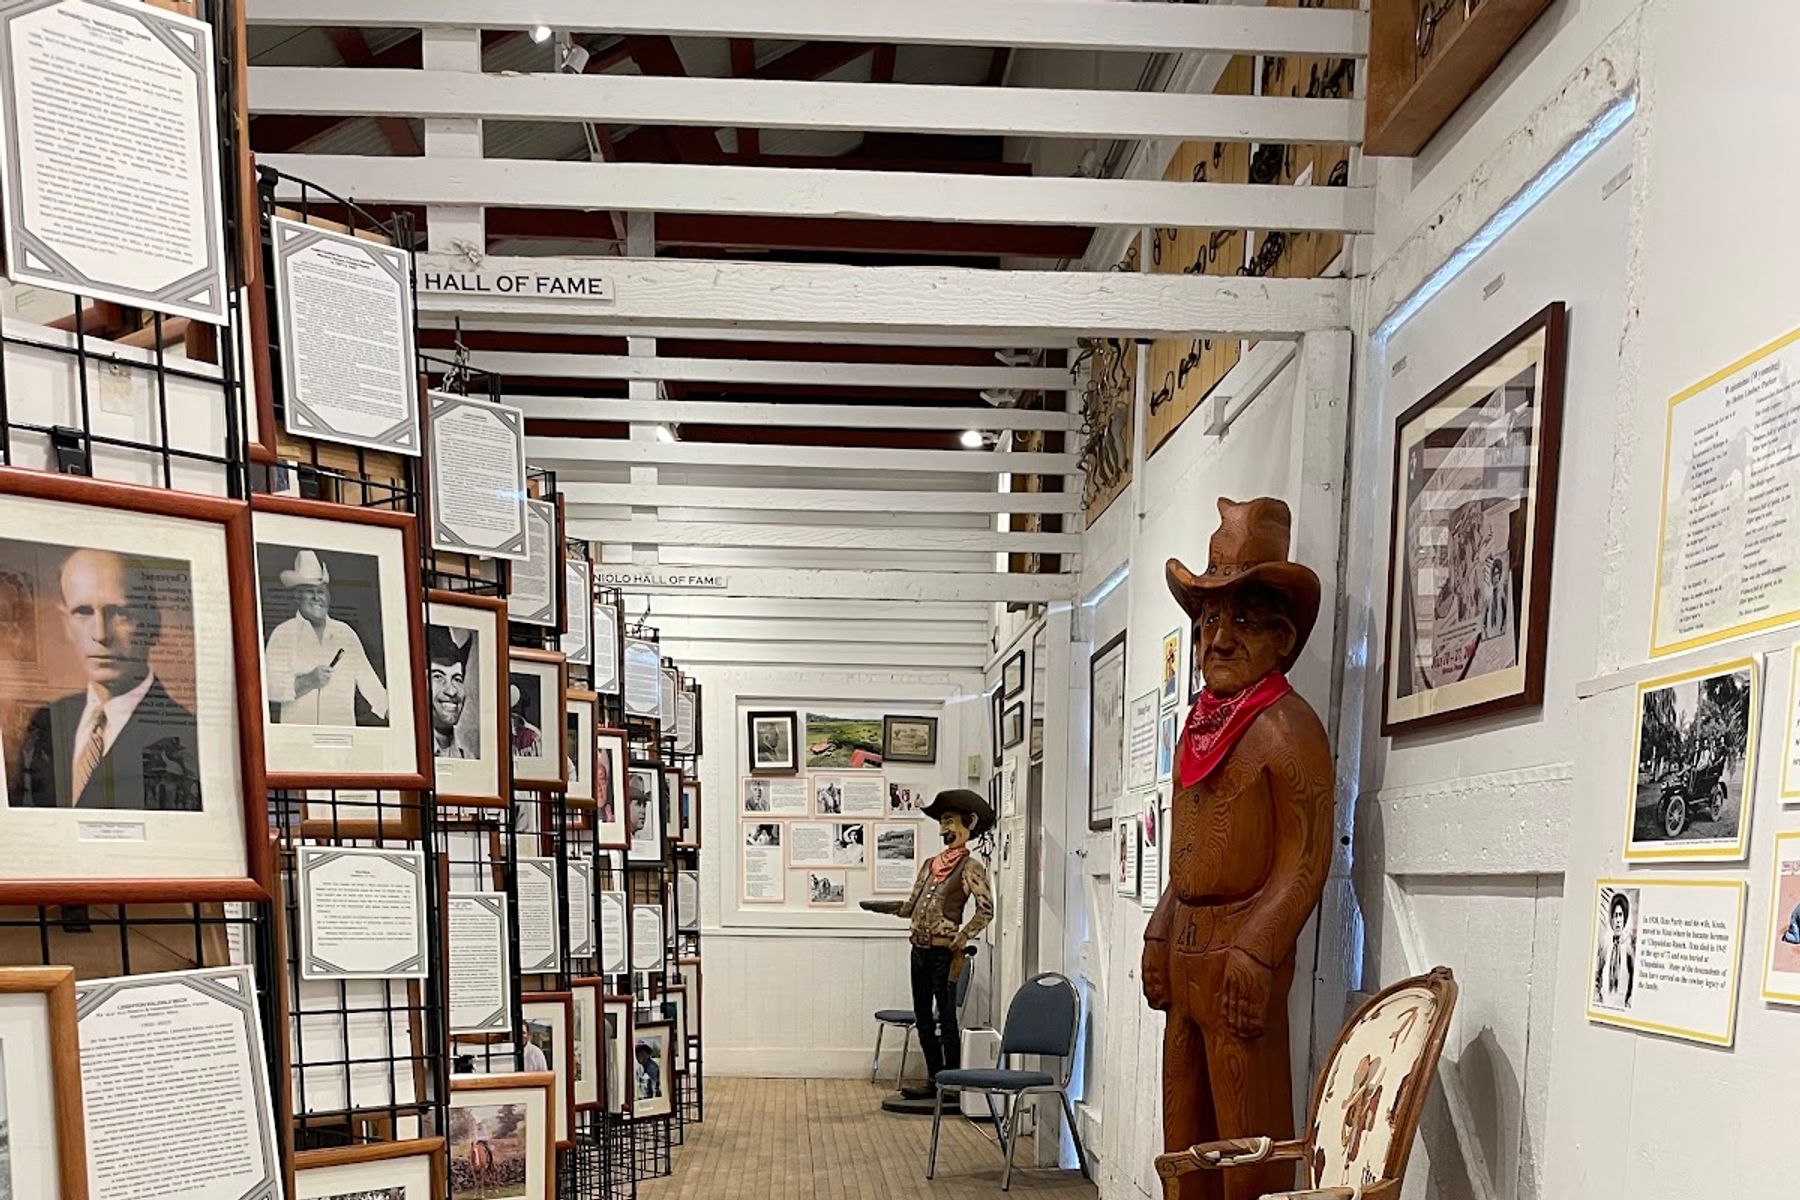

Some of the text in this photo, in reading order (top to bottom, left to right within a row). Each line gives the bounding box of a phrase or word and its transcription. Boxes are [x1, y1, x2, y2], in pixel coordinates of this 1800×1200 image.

[425, 273, 490, 291] HALL
[496, 275, 529, 292] OF
[536, 277, 603, 295] FAME
[634, 575, 667, 585] HALL
[669, 575, 687, 585] OF
[688, 576, 722, 586] FAME
